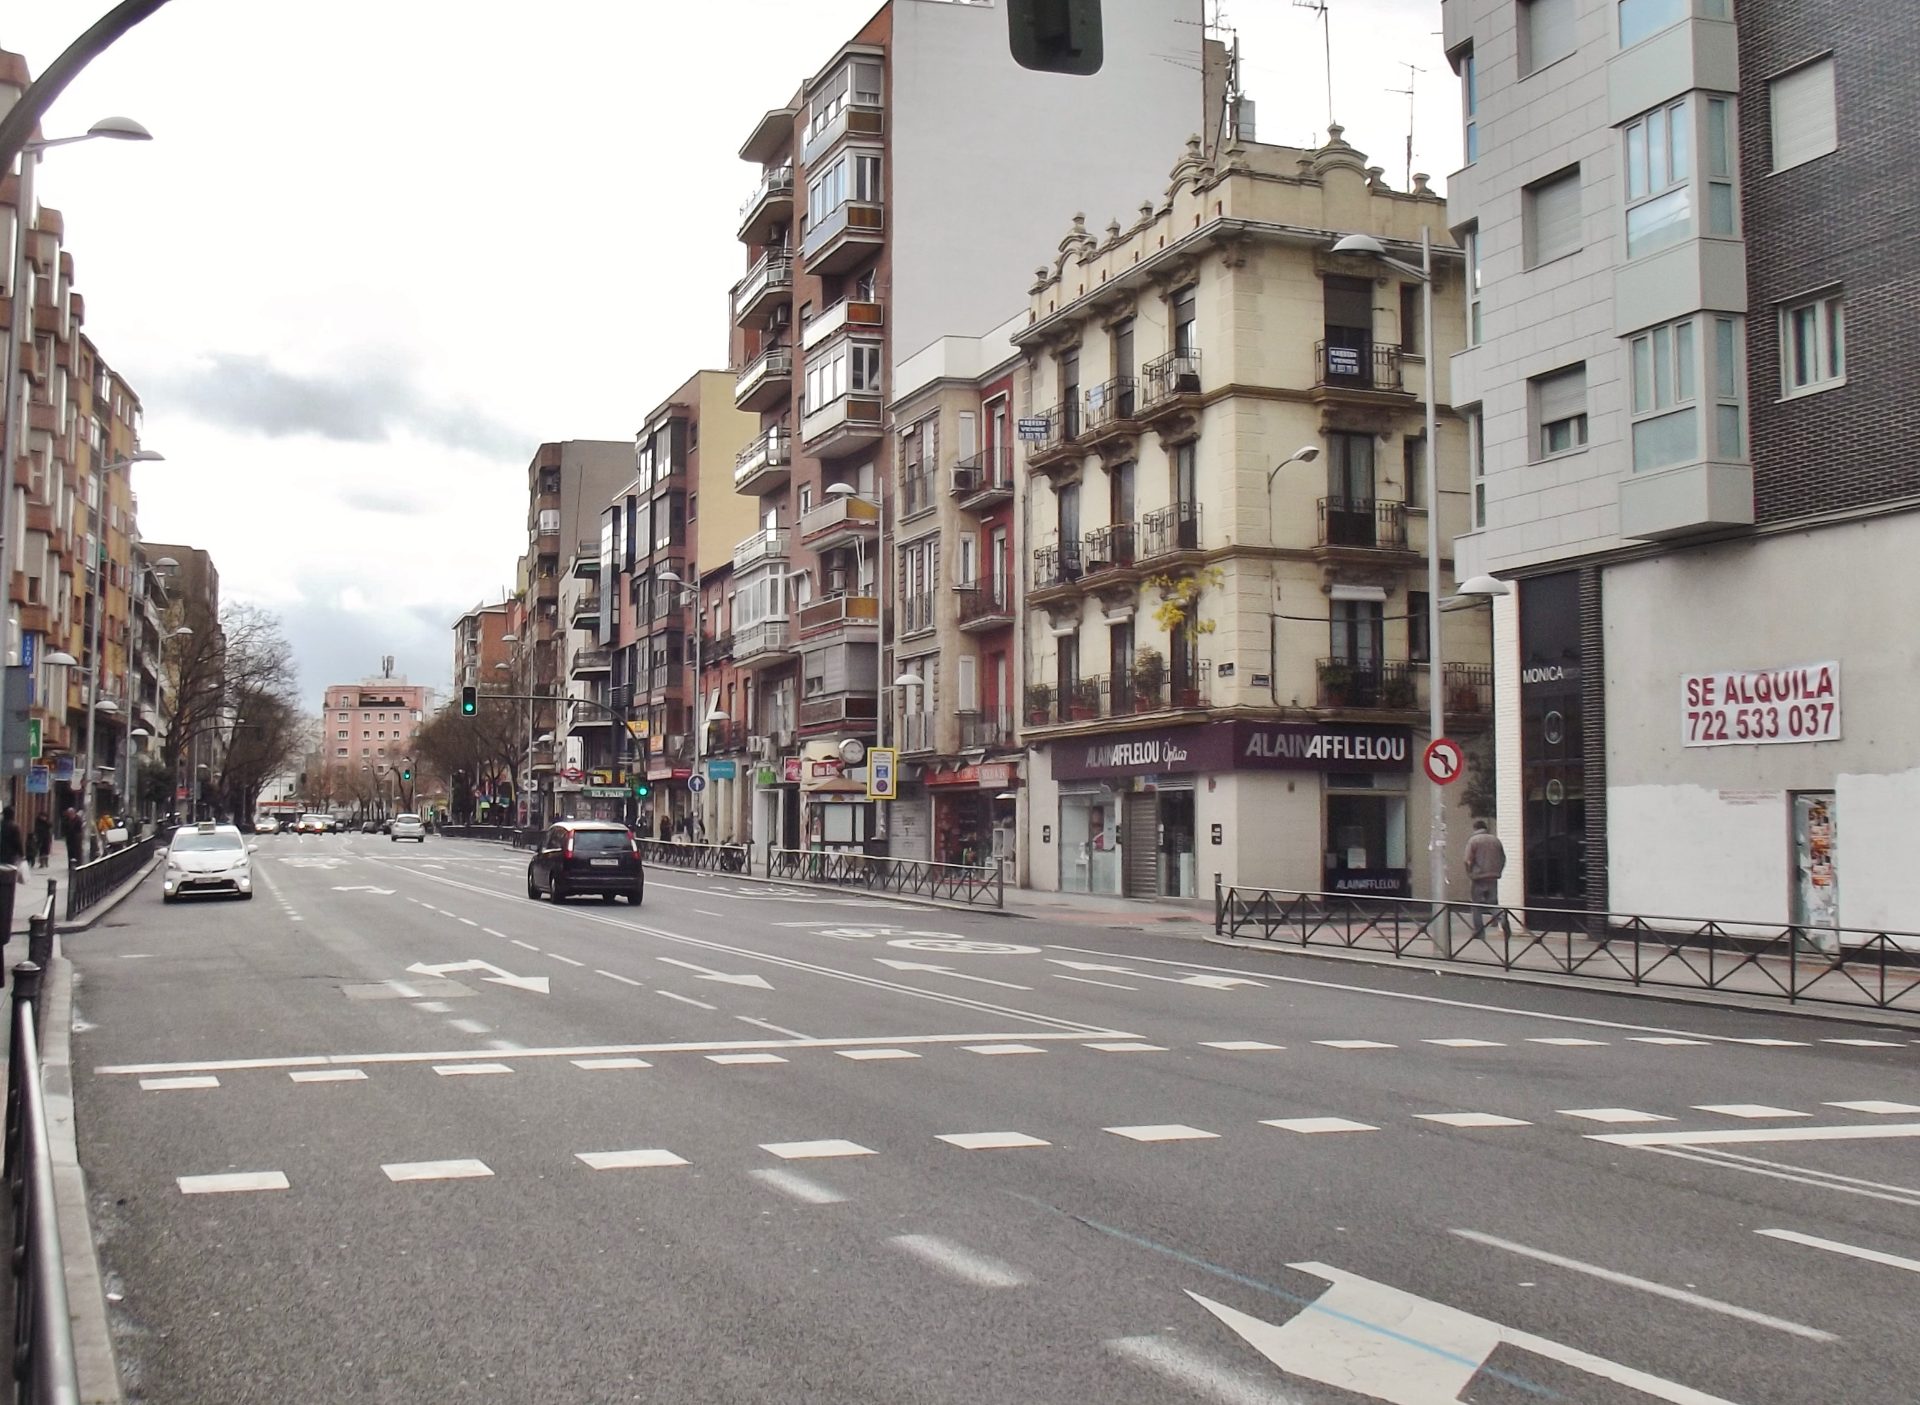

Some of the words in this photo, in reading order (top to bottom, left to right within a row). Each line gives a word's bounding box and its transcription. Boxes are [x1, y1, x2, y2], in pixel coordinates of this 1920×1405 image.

[1523, 666, 1564, 683] MONICA
[1687, 677, 1715, 707] SE
[1724, 667, 1834, 705] ALQUILA
[1688, 710, 1729, 741] 722
[1736, 707, 1779, 739] 533
[1789, 703, 1834, 736] 037
